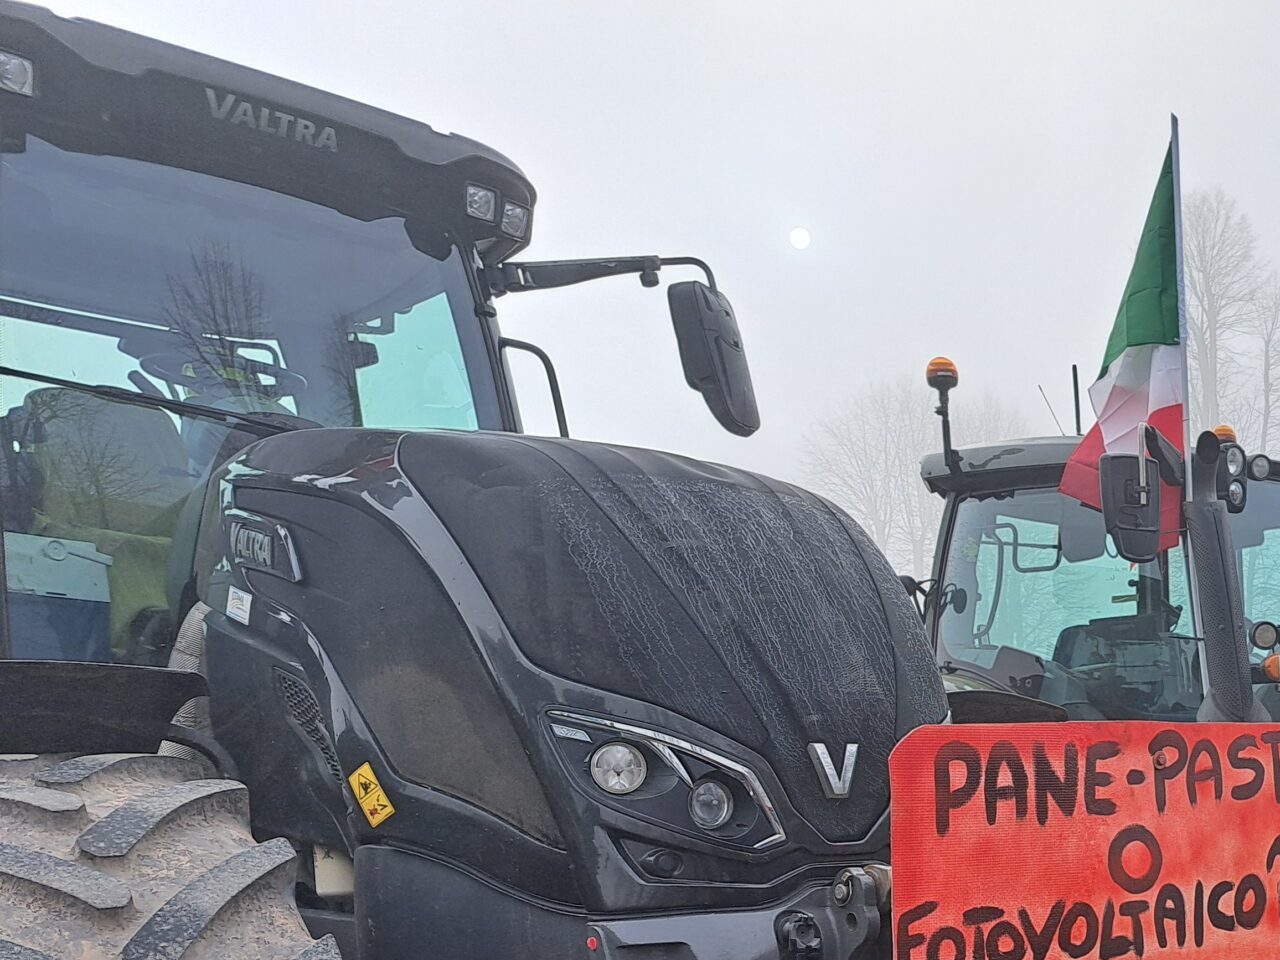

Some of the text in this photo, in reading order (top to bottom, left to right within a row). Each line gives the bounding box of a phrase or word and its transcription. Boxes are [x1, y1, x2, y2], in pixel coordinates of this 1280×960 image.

[205, 87, 338, 152] VALTRA
[230, 521, 272, 567] VALTRA
[1108, 824, 1162, 893] O
